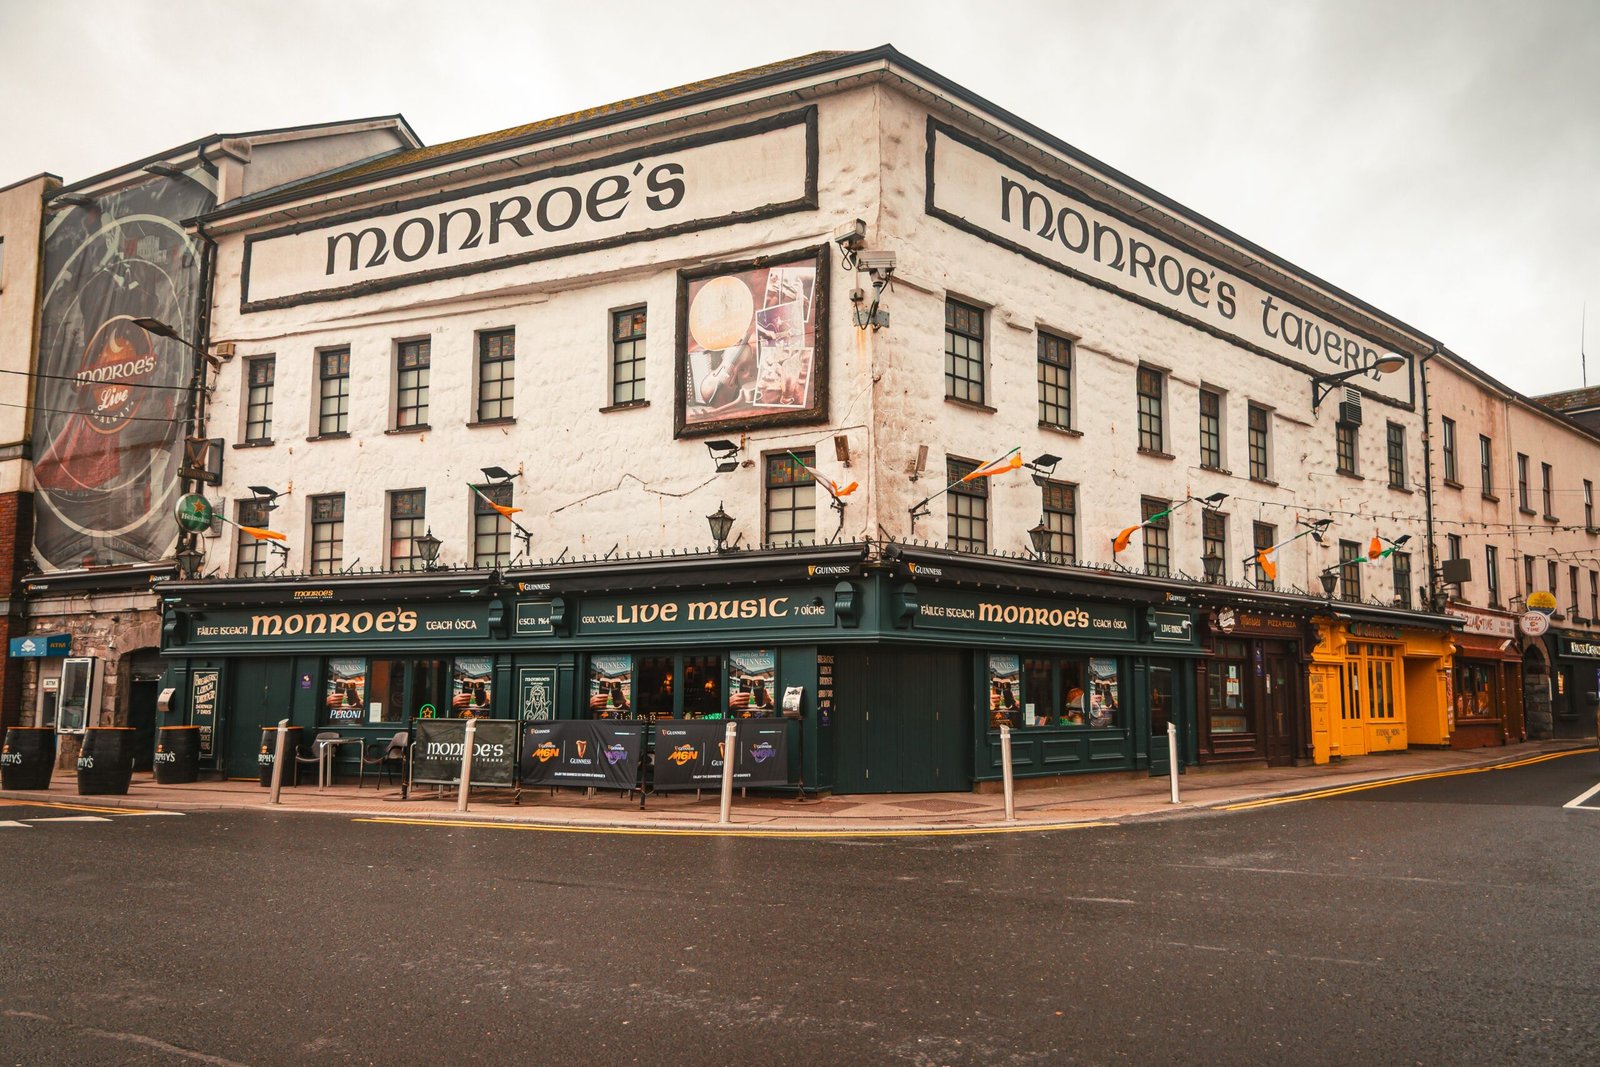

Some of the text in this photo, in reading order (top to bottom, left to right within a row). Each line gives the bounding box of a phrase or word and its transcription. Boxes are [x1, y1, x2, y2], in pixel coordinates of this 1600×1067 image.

[815, 566, 850, 575] GUINNESS
[914, 565, 942, 576] GUINNESS
[524, 583, 550, 591] GUINNESS
[616, 602, 678, 624] LIVE
[688, 597, 789, 621] MUSIC
[794, 607, 800, 615] 7
[978, 602, 1090, 628] MONROE'S
[251, 607, 418, 636] MONROE'S
[426, 620, 453, 630] TEACH
[329, 709, 361, 719] PERONI
